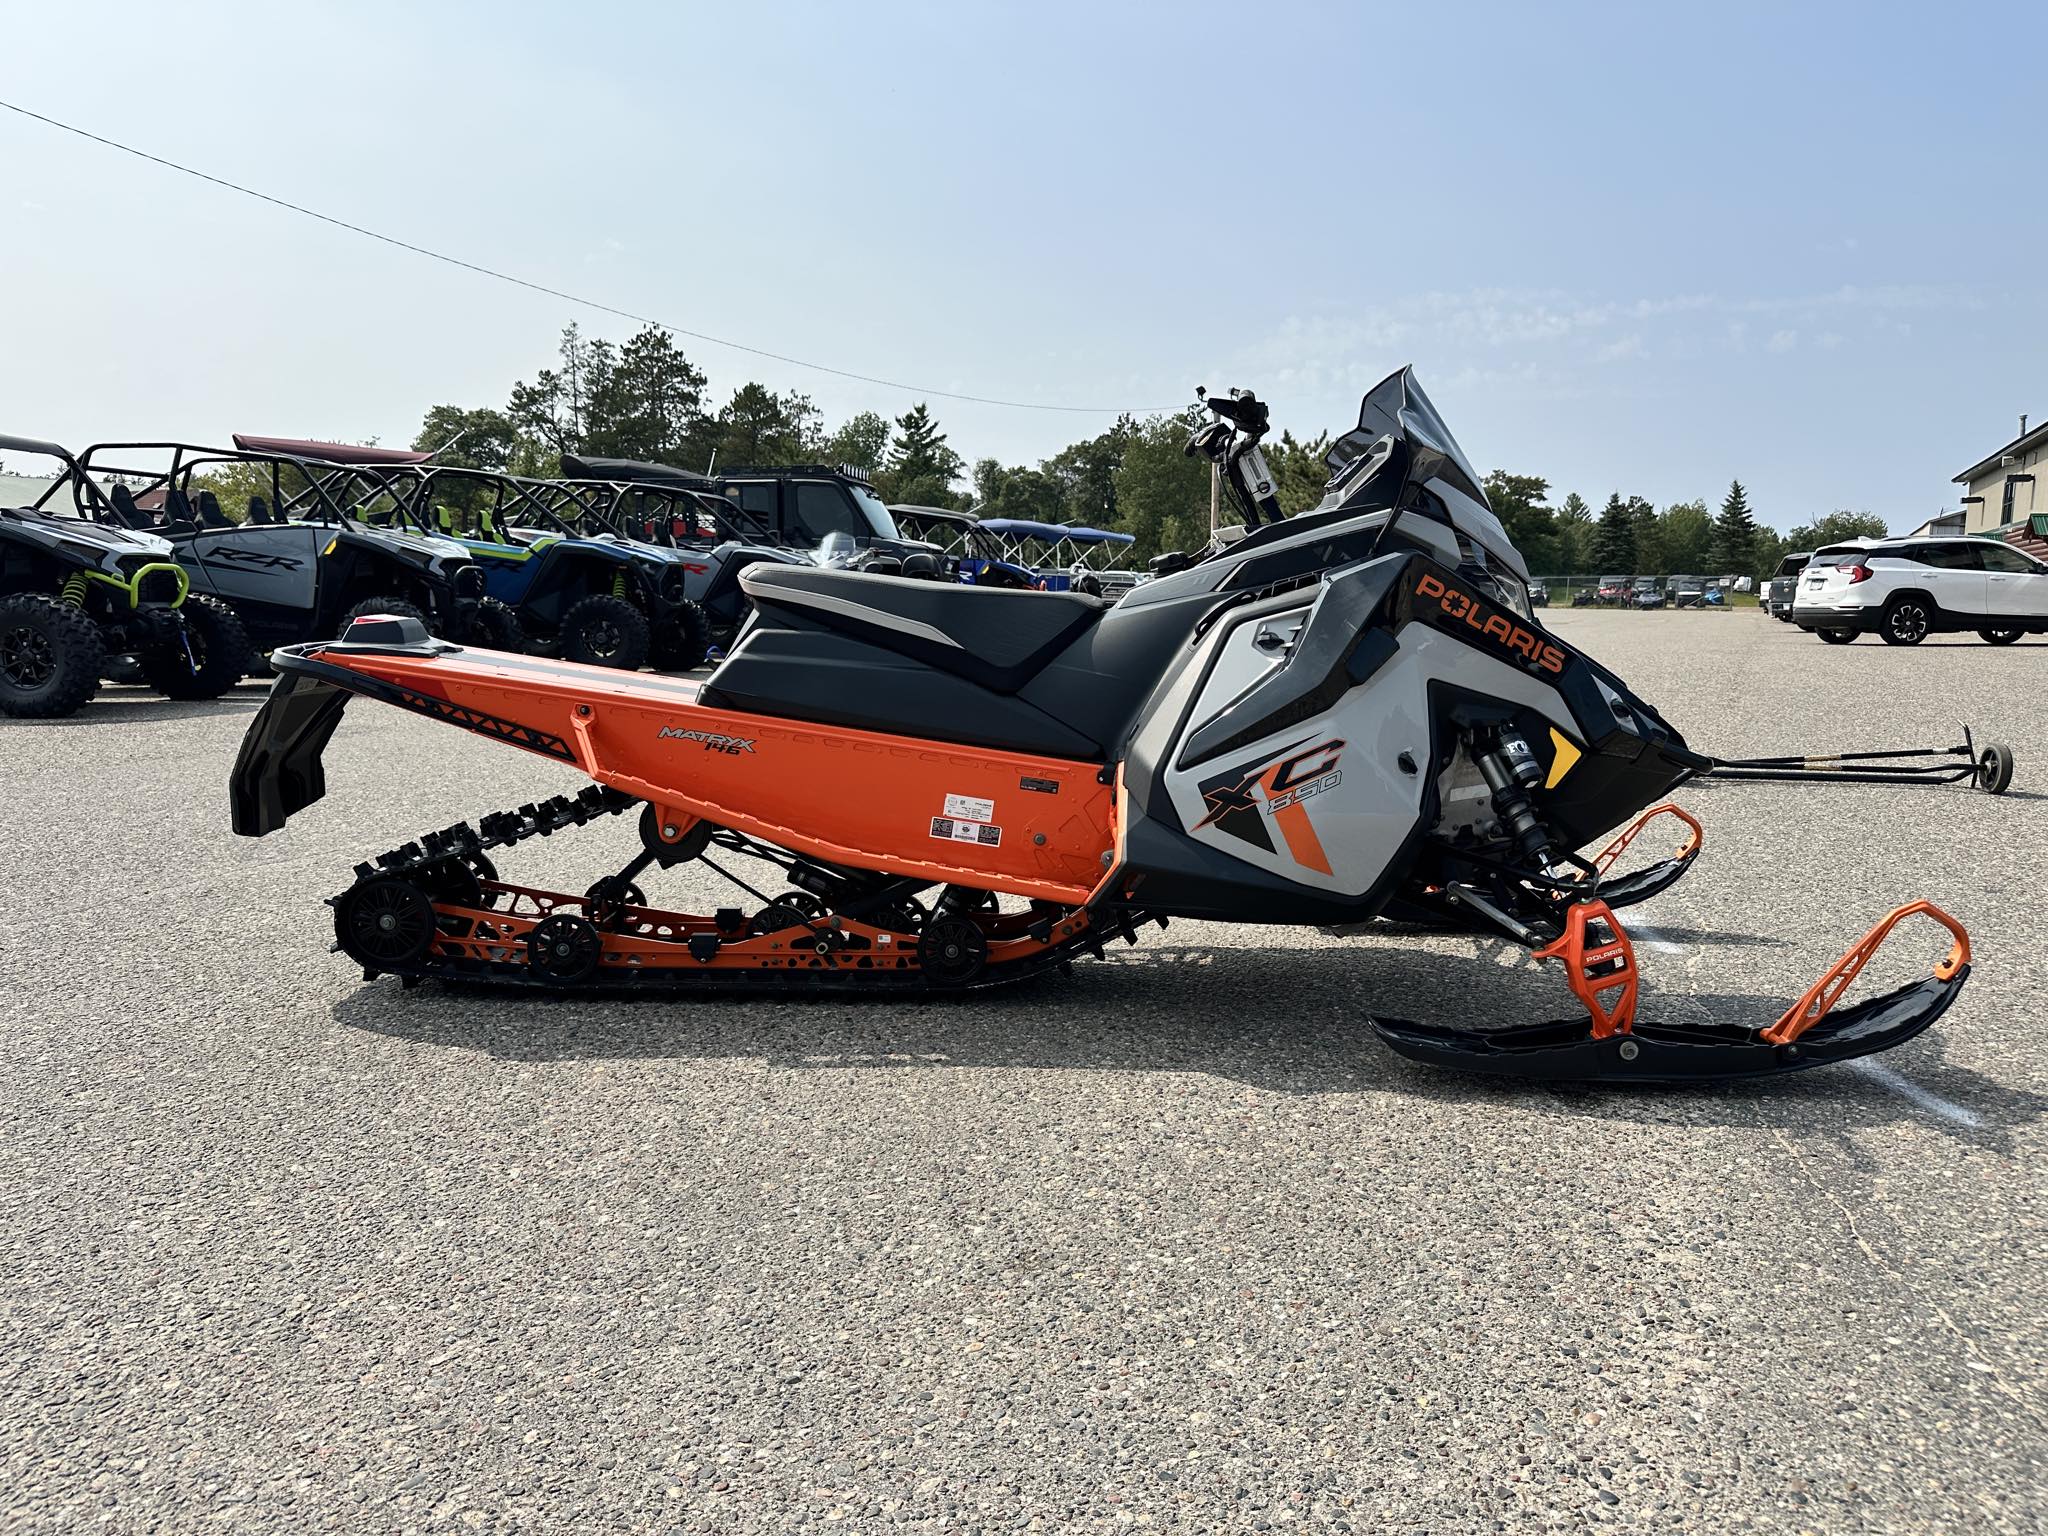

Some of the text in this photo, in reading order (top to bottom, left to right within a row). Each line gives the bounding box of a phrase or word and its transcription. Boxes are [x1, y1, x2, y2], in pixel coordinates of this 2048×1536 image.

[205, 546, 305, 572] RZR
[1415, 574, 1567, 673] POLARIS
[657, 727, 757, 753] MATRYX
[704, 741, 742, 755] 146
[1190, 738, 1348, 832] XC
[1267, 769, 1343, 815] 850
[1586, 947, 1624, 962] POLARIS
